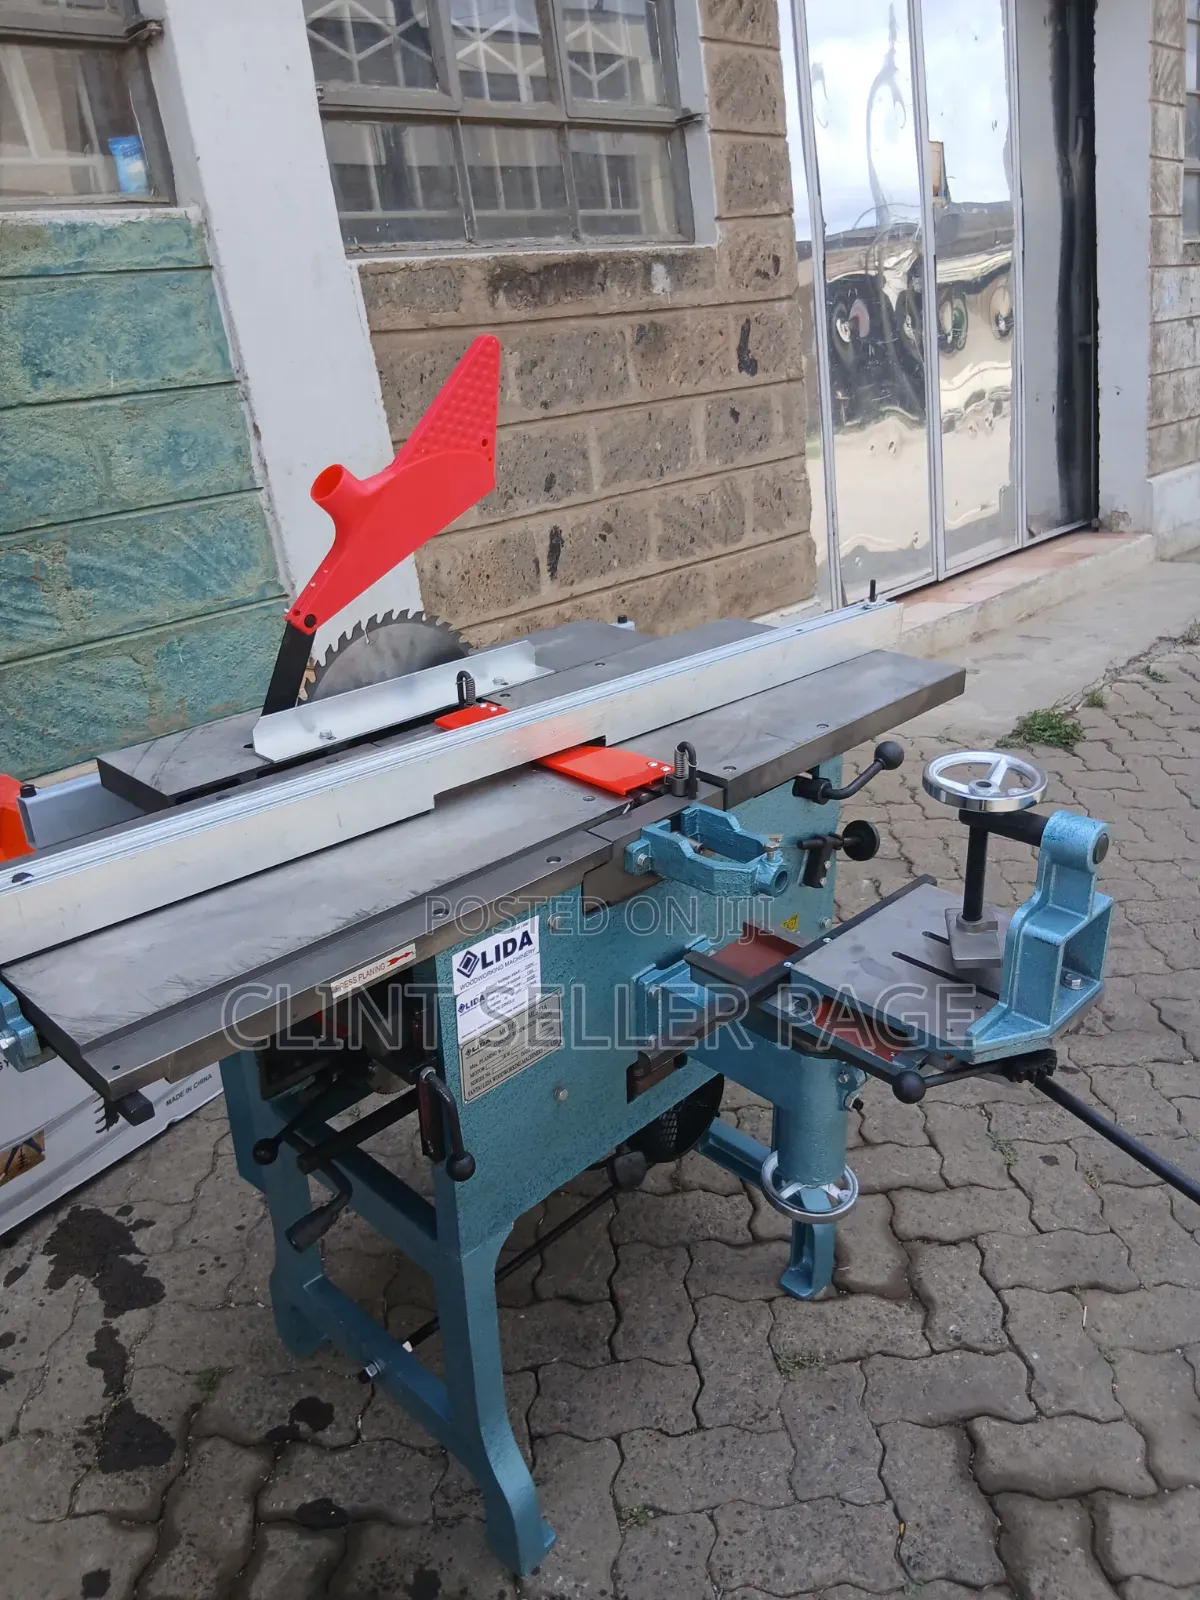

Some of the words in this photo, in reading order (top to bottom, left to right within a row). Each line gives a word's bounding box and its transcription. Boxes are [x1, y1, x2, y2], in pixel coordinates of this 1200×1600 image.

[480, 930, 533, 970] LIDA
[358, 963, 386, 981] PLANING
[460, 964, 504, 991] WOODWORKING
[505, 947, 536, 969] MACHINERY
[464, 994, 486, 1010] LIDA
[166, 1090, 184, 1106] MADE
[186, 1086, 192, 1094] IN
[193, 1074, 212, 1089] CHINA
